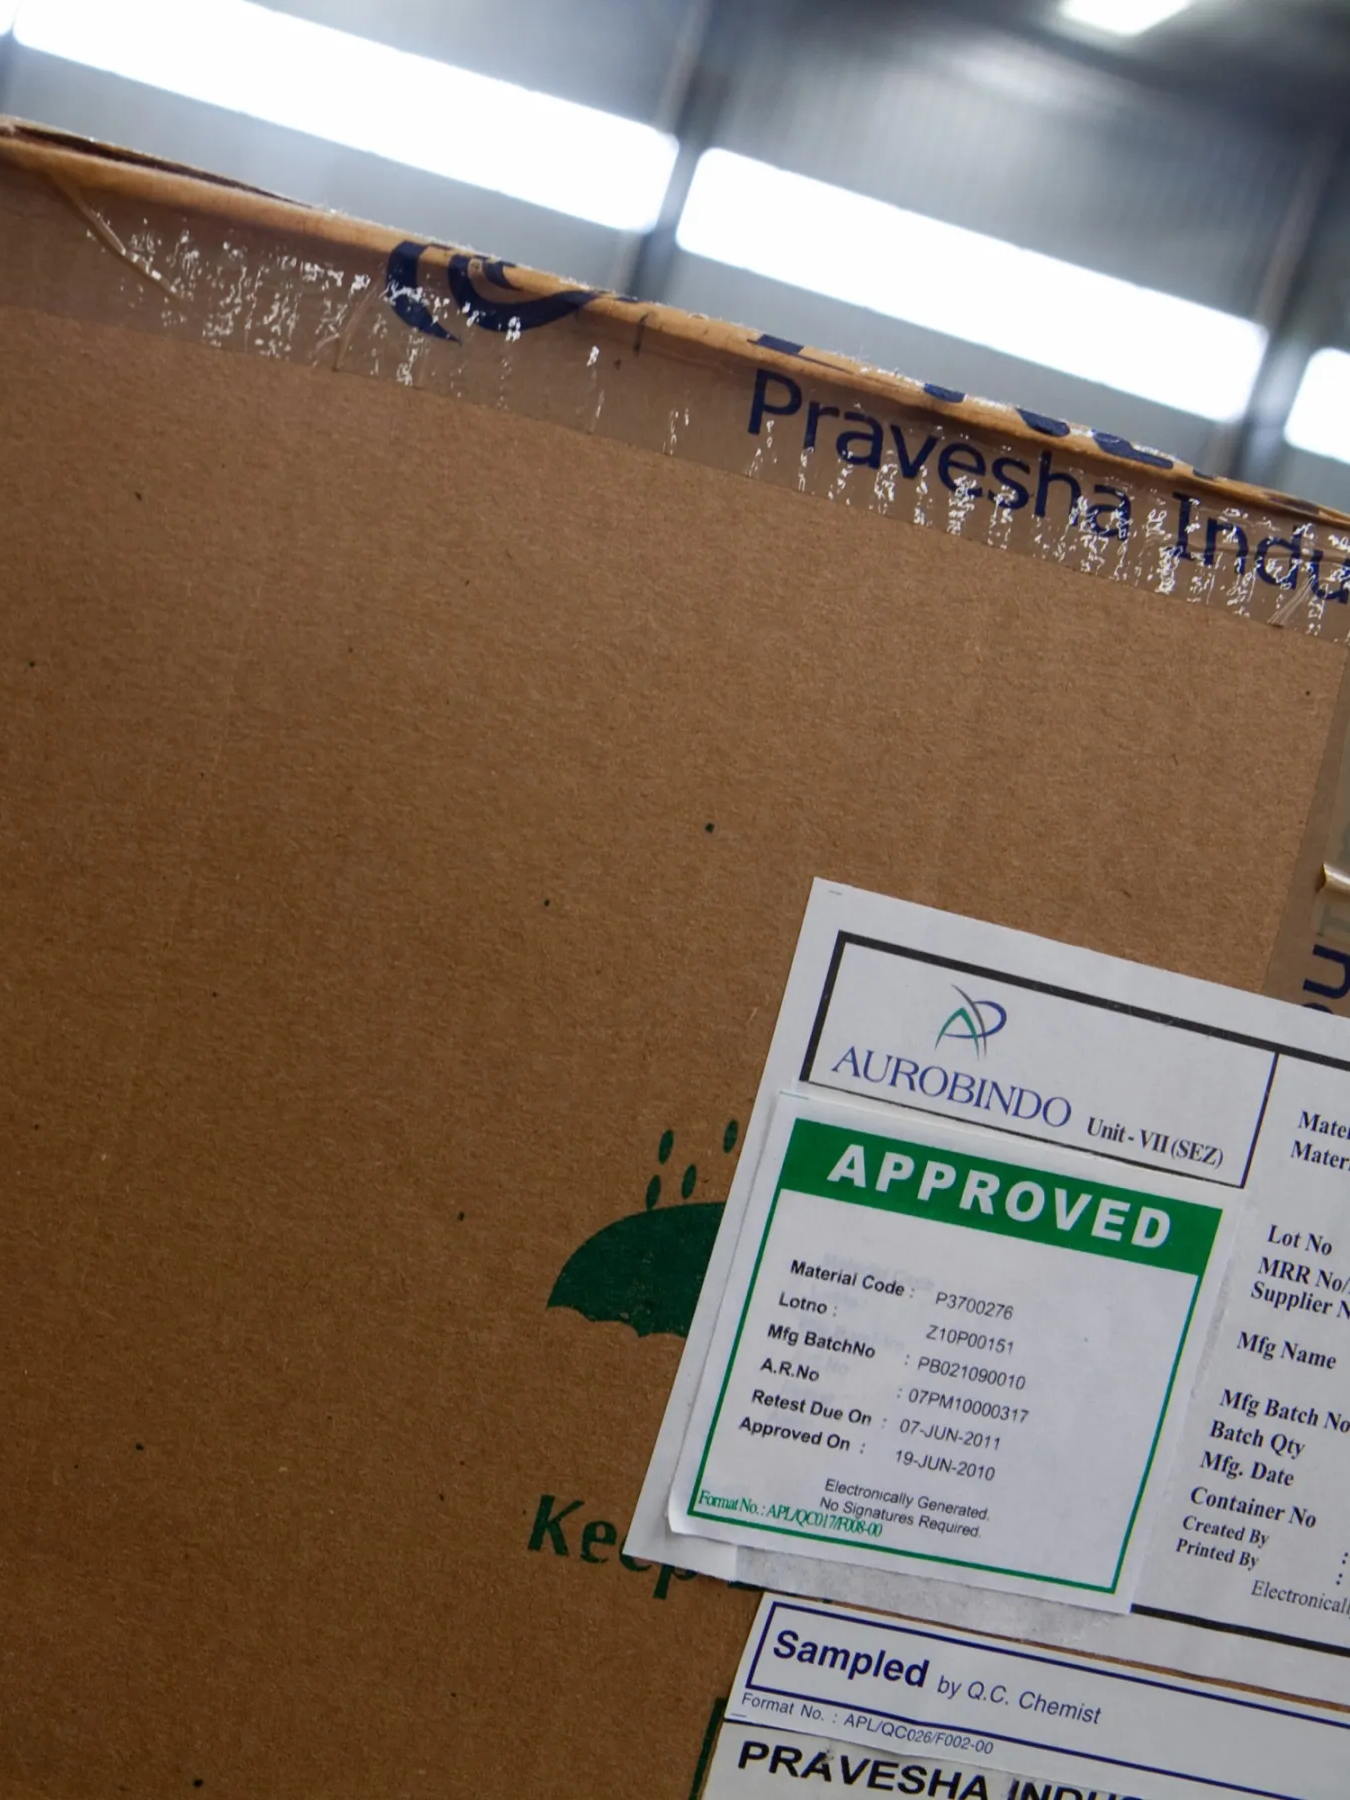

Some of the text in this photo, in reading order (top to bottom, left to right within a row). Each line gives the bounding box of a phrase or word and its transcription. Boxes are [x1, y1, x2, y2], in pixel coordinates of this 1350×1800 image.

[747, 367, 1133, 540] Pravesha
[831, 1045, 1072, 1128] AUROBINDO
[1087, 1116, 1127, 1144] Unit
[1290, 1139, 1350, 1172] Mater
[827, 1143, 1172, 1250] APPROVED
[1267, 1224, 1332, 1256] Lot No
[790, 1259, 858, 1287] Material
[862, 1274, 905, 1297] Code
[936, 1291, 1014, 1321] P3700276
[1258, 1256, 1350, 1295] MRR No/
[1250, 1280, 1333, 1315] Supplier
[778, 1292, 828, 1315] Lotno
[926, 1325, 1015, 1355] Z10P00151
[767, 1324, 799, 1346] Mfg
[804, 1331, 876, 1359] BatchNo
[917, 1356, 1026, 1391] PB021090010
[1236, 1331, 1337, 1370] Mfg Name
[760, 1358, 820, 1382] A.R.No
[908, 1388, 1029, 1424] 07PM10000317
[1219, 1388, 1350, 1434] Mfg Batch No
[751, 1389, 806, 1413] Retest
[810, 1401, 844, 1421] Due
[848, 1409, 872, 1427] On
[900, 1418, 1000, 1451] 07-JUN-2011
[1209, 1419, 1306, 1460] Batch Qty
[739, 1416, 822, 1446] Approved
[826, 1434, 851, 1452] On
[895, 1450, 995, 1482] 19-JUN-2010
[1200, 1450, 1295, 1487] Mfg. Date
[698, 1489, 738, 1511] Format
[820, 1497, 982, 1539] No Signatures Required.
[825, 1478, 990, 1522] Electronically Generated.
[1190, 1486, 1317, 1529] Container No
[1182, 1514, 1246, 1542] Created
[1248, 1528, 1270, 1549] By
[1176, 1538, 1236, 1564] Printed
[1238, 1550, 1260, 1571] By
[1251, 1579, 1350, 1620] Electronicall
[773, 1629, 1102, 1725] Sampled by Q.C. Chemist
[741, 1691, 794, 1715] Format
[799, 1701, 825, 1722] No.
[843, 1713, 995, 1756] APL/QC026/F002-00
[737, 1740, 989, 1800] PRAVESHA
